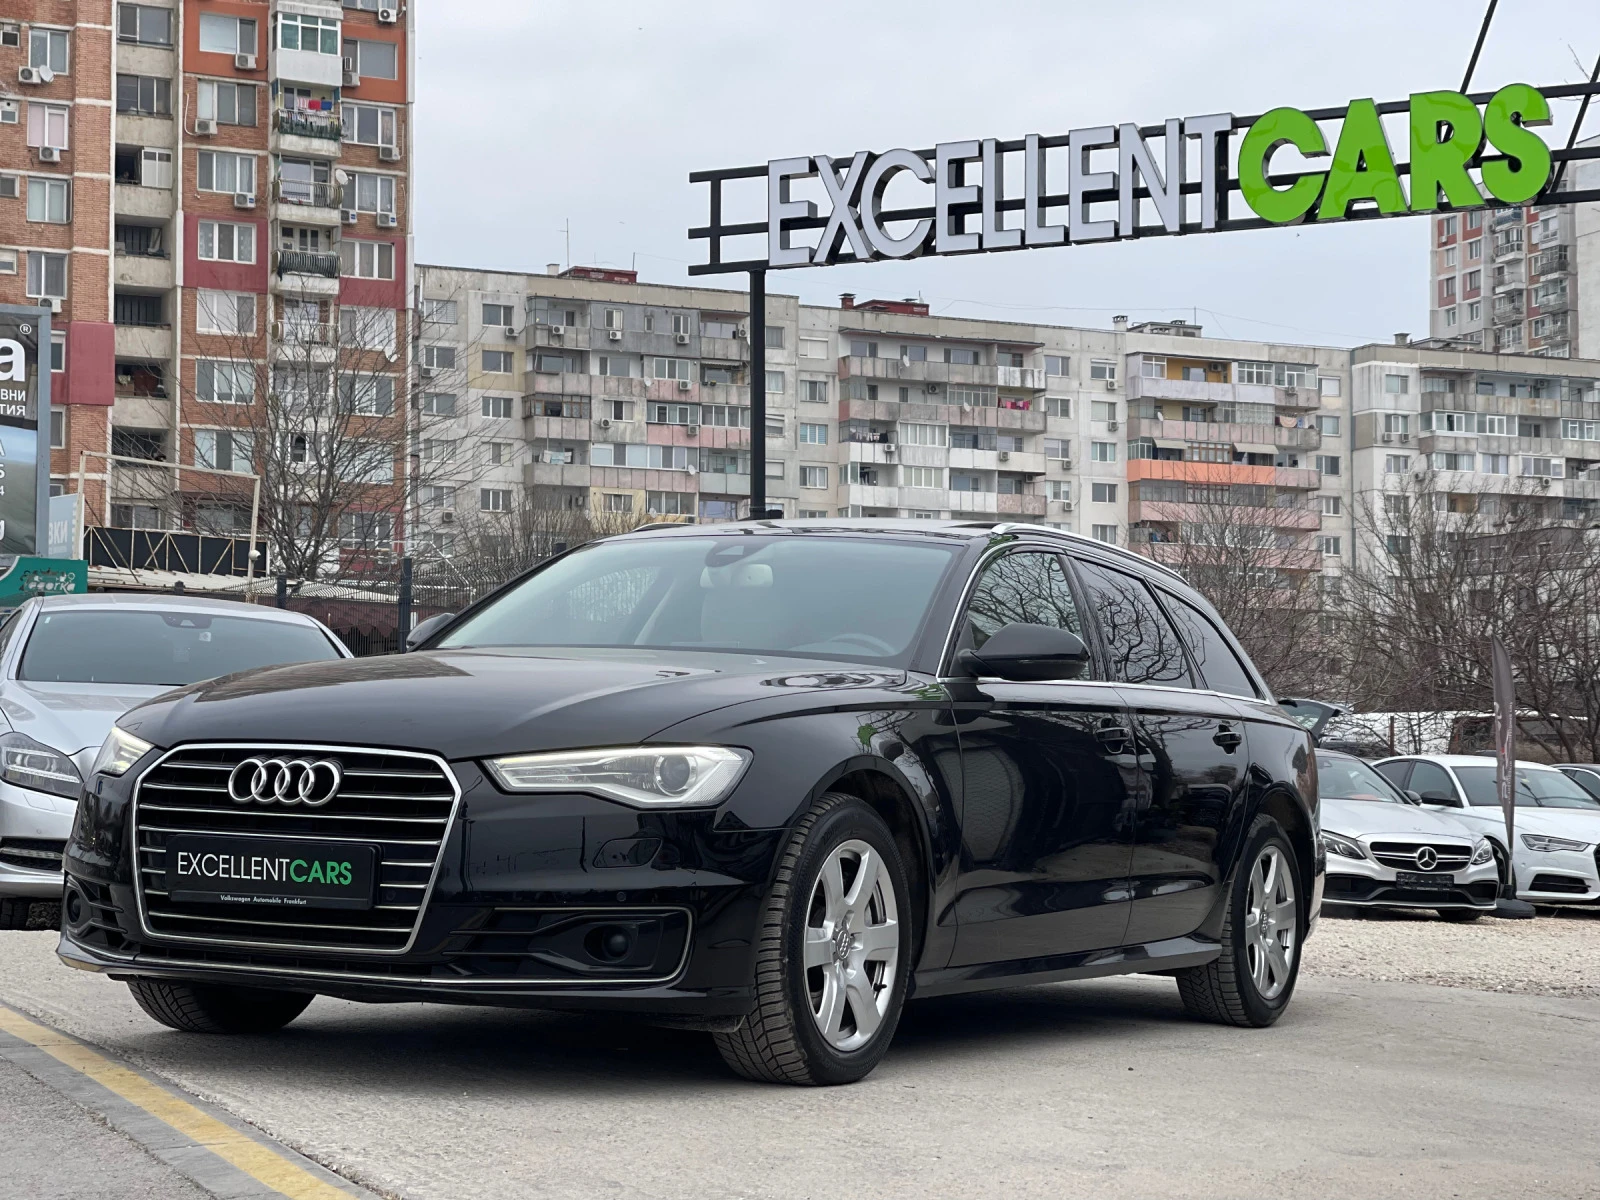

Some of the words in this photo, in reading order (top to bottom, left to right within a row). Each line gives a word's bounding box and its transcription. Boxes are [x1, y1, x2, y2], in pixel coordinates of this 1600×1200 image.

[220, 894, 251, 903] Volkswagen
[252, 896, 281, 904] Automobile
[283, 897, 307, 905] Frankfurt
